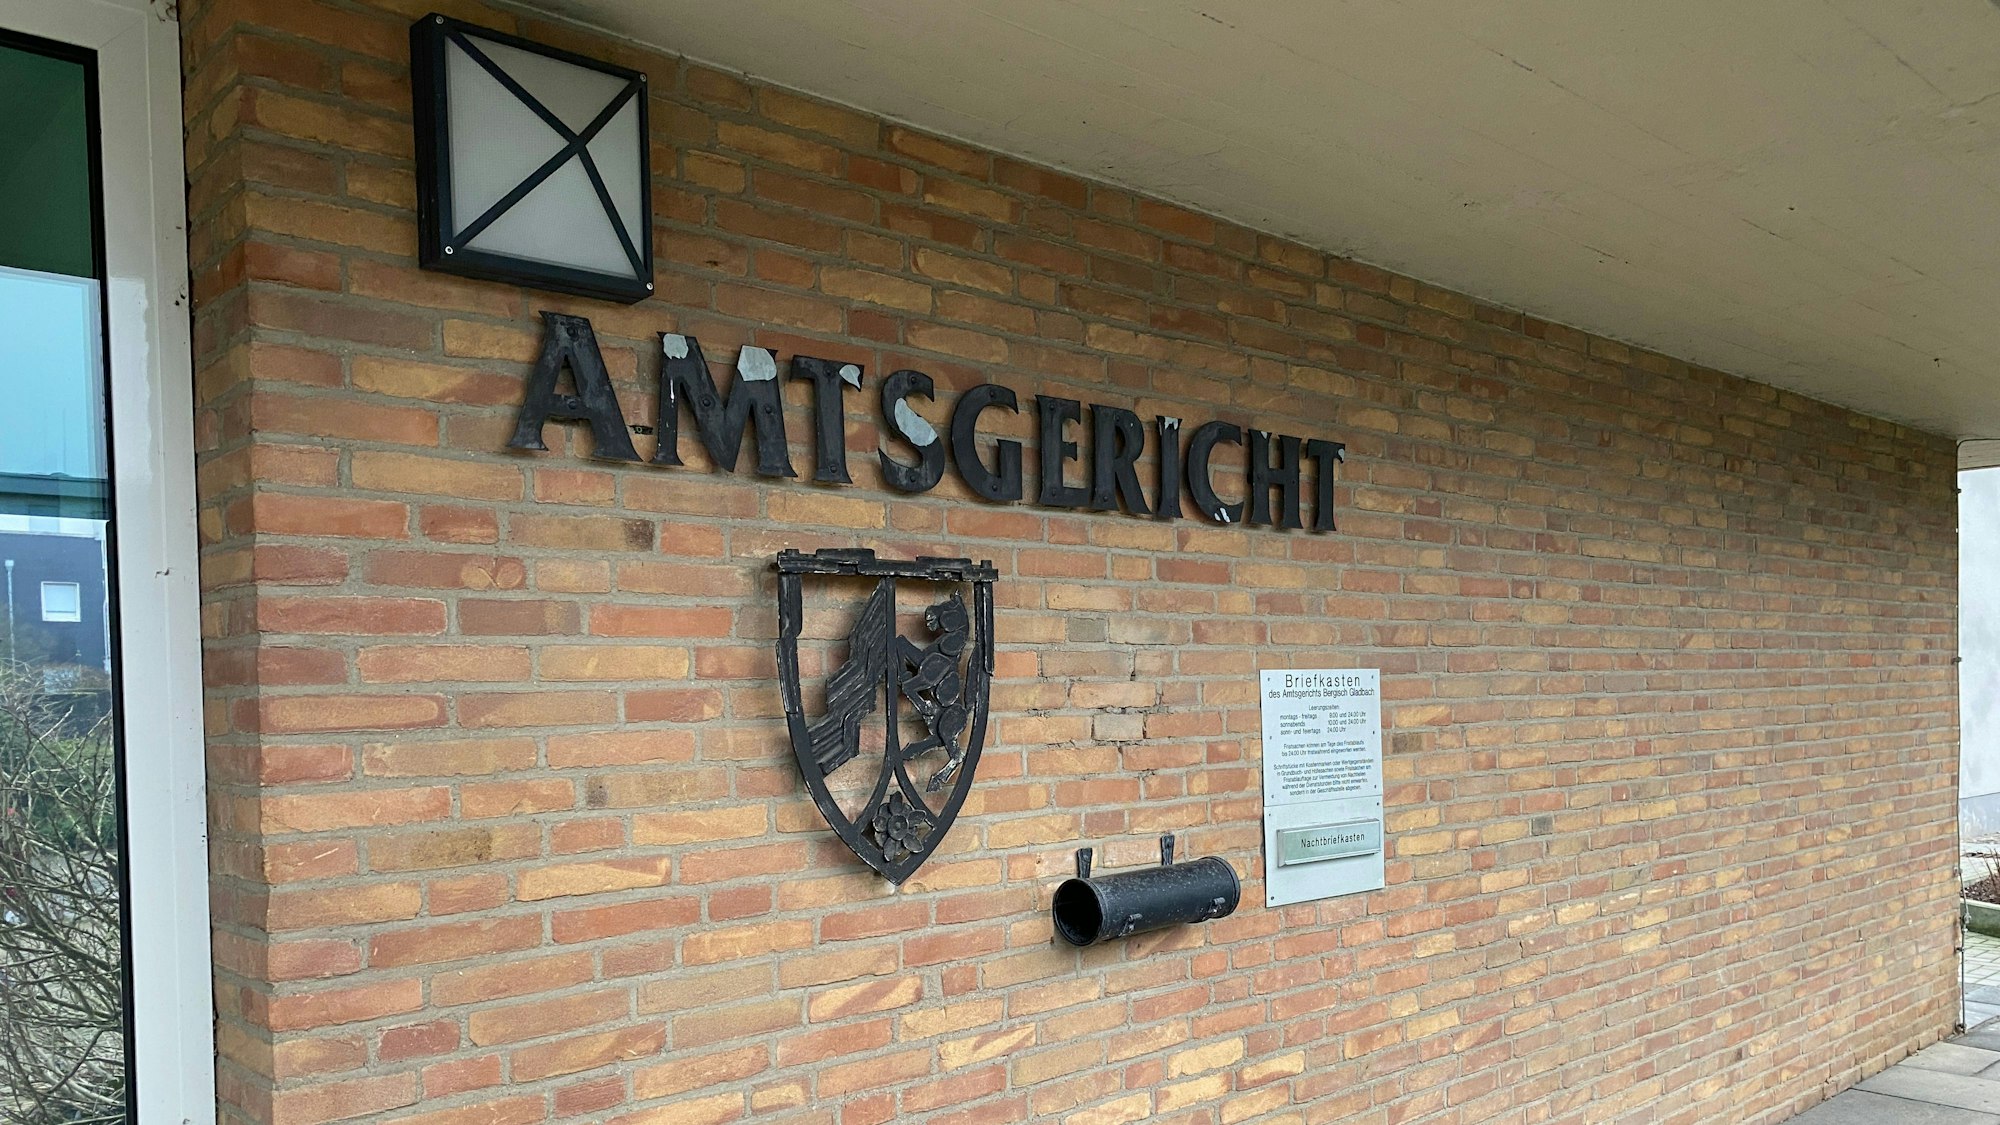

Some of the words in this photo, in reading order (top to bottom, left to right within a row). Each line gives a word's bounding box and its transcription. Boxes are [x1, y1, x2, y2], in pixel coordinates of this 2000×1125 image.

[505, 310, 1346, 531] AMTSGERICHT
[1286, 674, 1360, 687] Briefkasten
[1269, 690, 1280, 698] des
[1282, 689, 1321, 699] Amtsgerichts
[1323, 689, 1347, 698] Bergisch
[1349, 688, 1374, 696] Gladbach
[1301, 834, 1364, 848] Nachtbriefkasten
